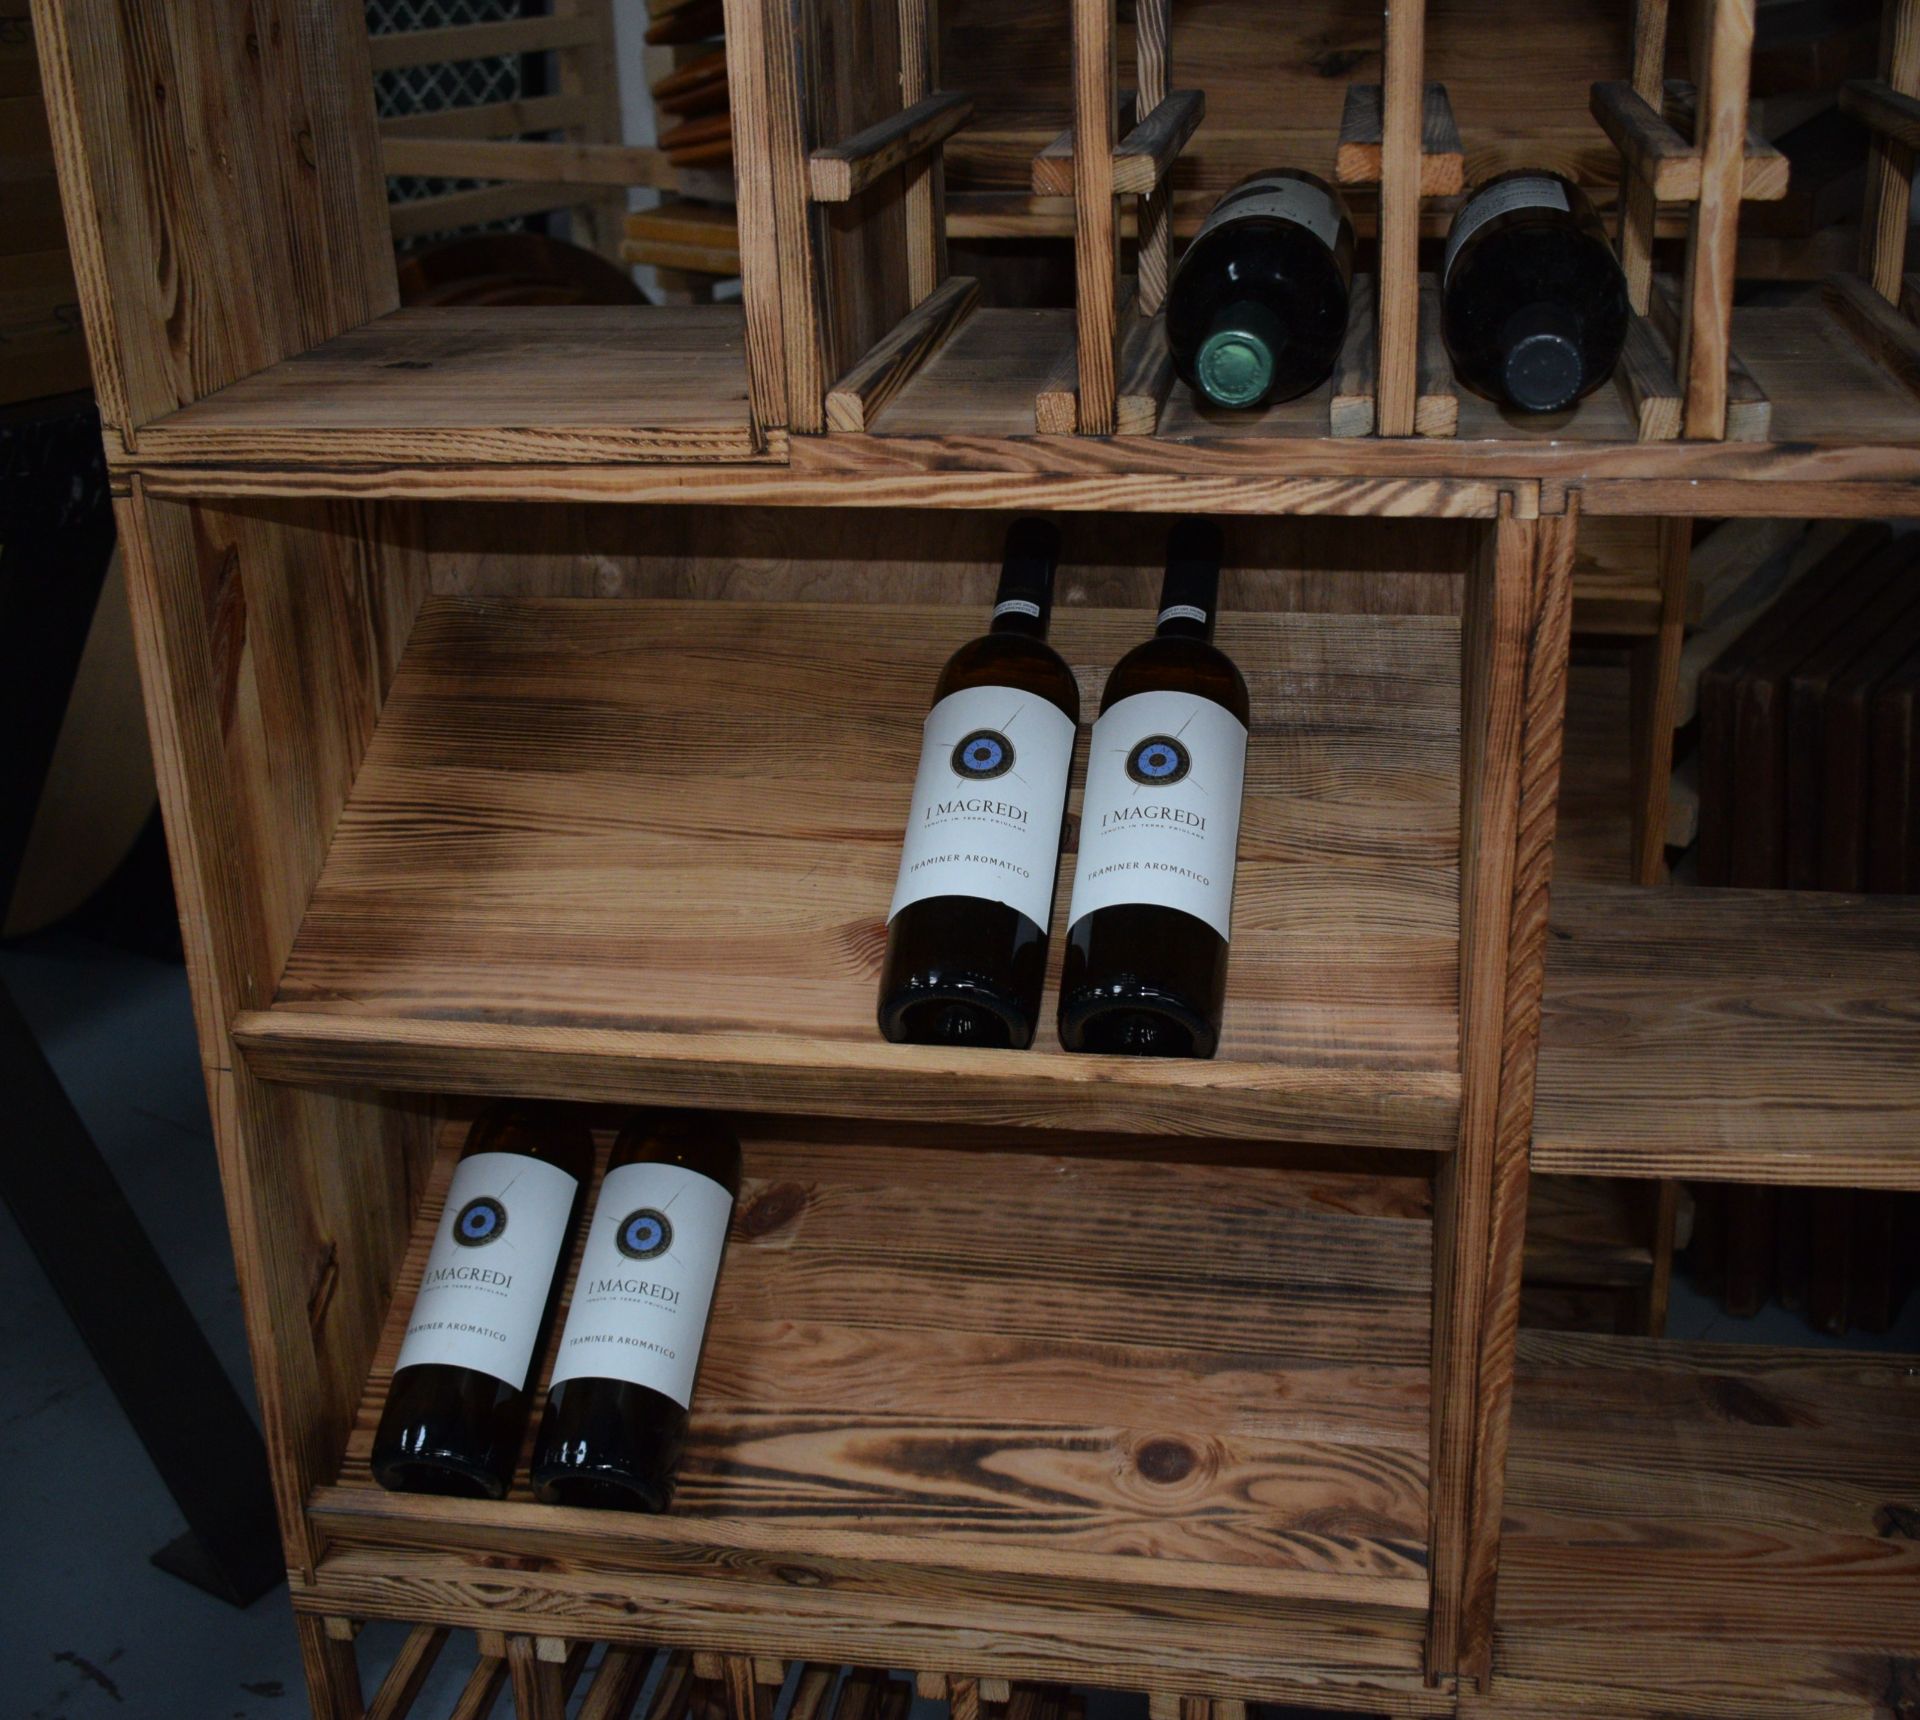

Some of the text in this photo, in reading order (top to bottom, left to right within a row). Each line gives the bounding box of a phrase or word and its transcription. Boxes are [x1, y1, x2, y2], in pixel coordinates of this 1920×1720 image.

[926, 798, 1028, 824] I MAGREDI
[1102, 806, 1208, 831] I MAGREDI
[910, 854, 1030, 879] TRAMINER AROMATICO
[1087, 861, 1210, 886] TRAMINER AROMATICO
[434, 1266, 512, 1288] MAGREDI
[588, 1279, 680, 1305] I MAGREDI
[446, 1322, 507, 1342] AROMATICO
[569, 1335, 676, 1359] TRAMINER AROMATICO
